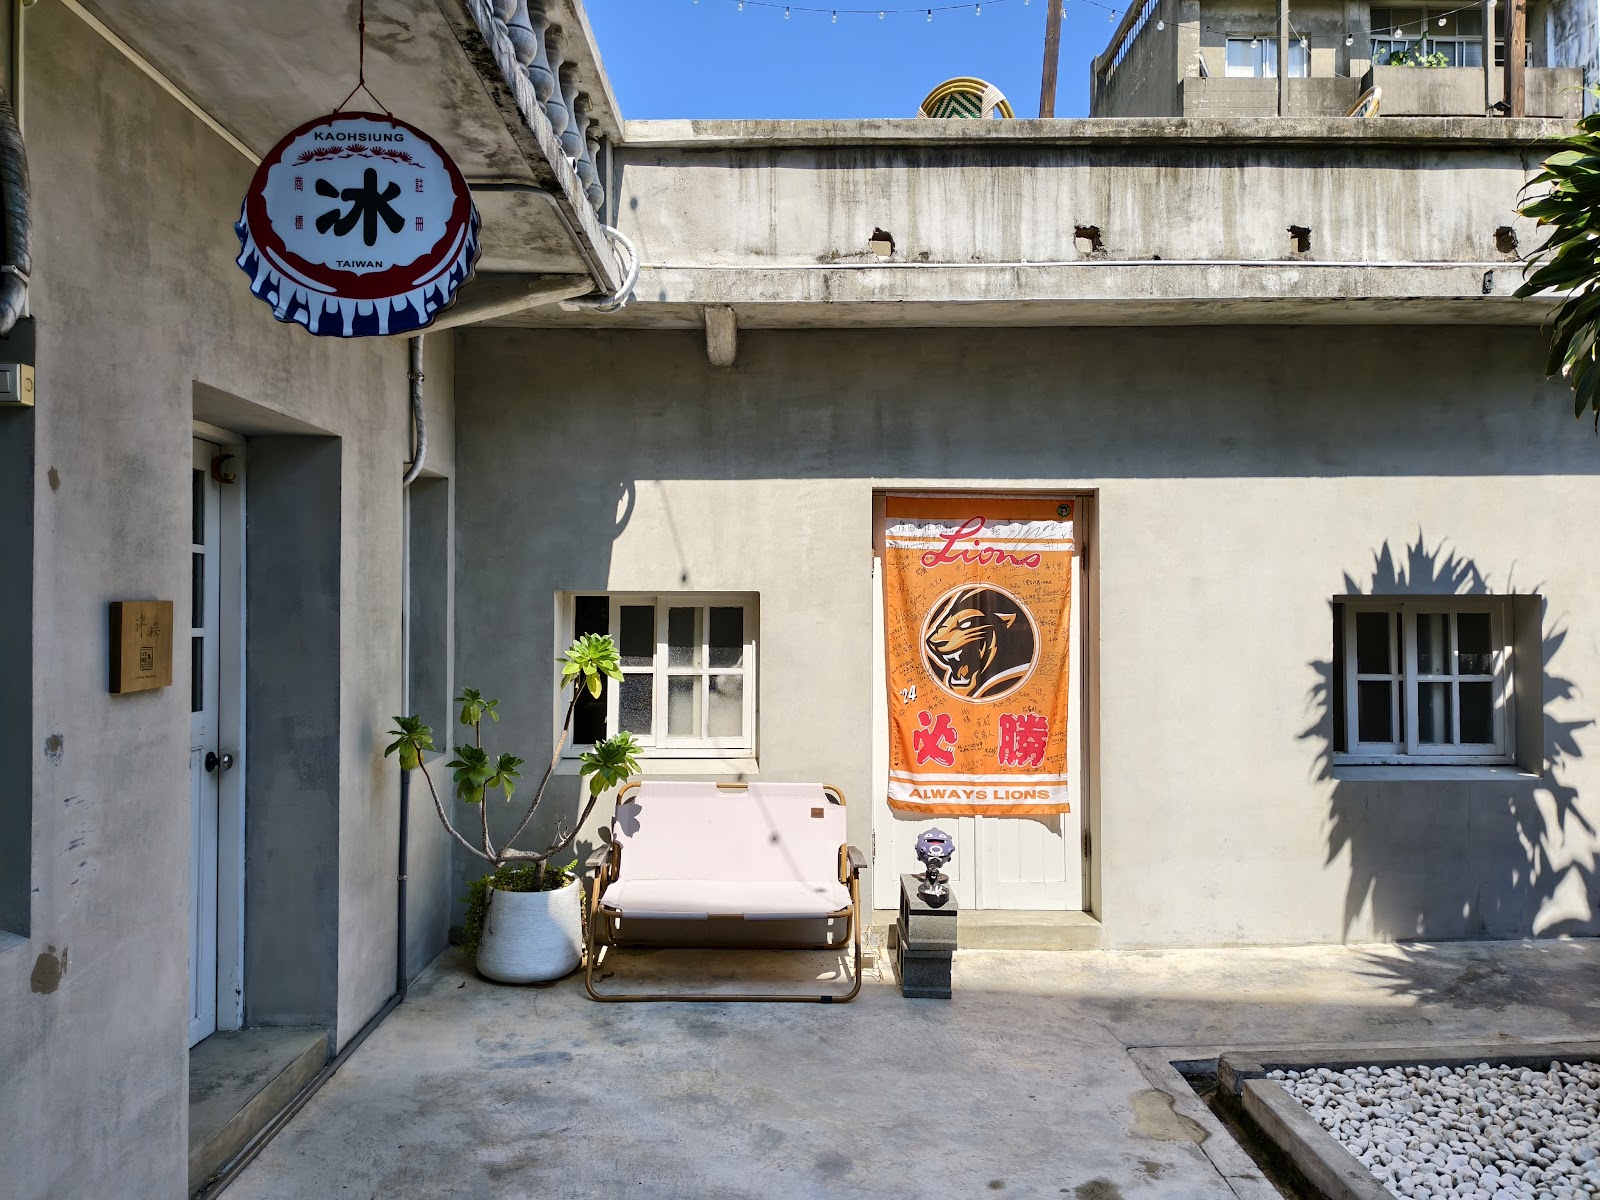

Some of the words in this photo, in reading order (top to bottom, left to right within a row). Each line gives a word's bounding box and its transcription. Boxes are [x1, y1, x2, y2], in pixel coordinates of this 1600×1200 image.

[314, 132, 405, 142] KAOHSIUNG
[294, 176, 304, 230] 商標
[315, 168, 405, 247] 冰
[415, 178, 424, 232] 註冊
[336, 260, 383, 269] TAIWAN
[920, 515, 1042, 569] Lions
[912, 710, 1049, 767] 必勝
[908, 789, 988, 800] ALWAYS
[993, 789, 1050, 800] LIONS
